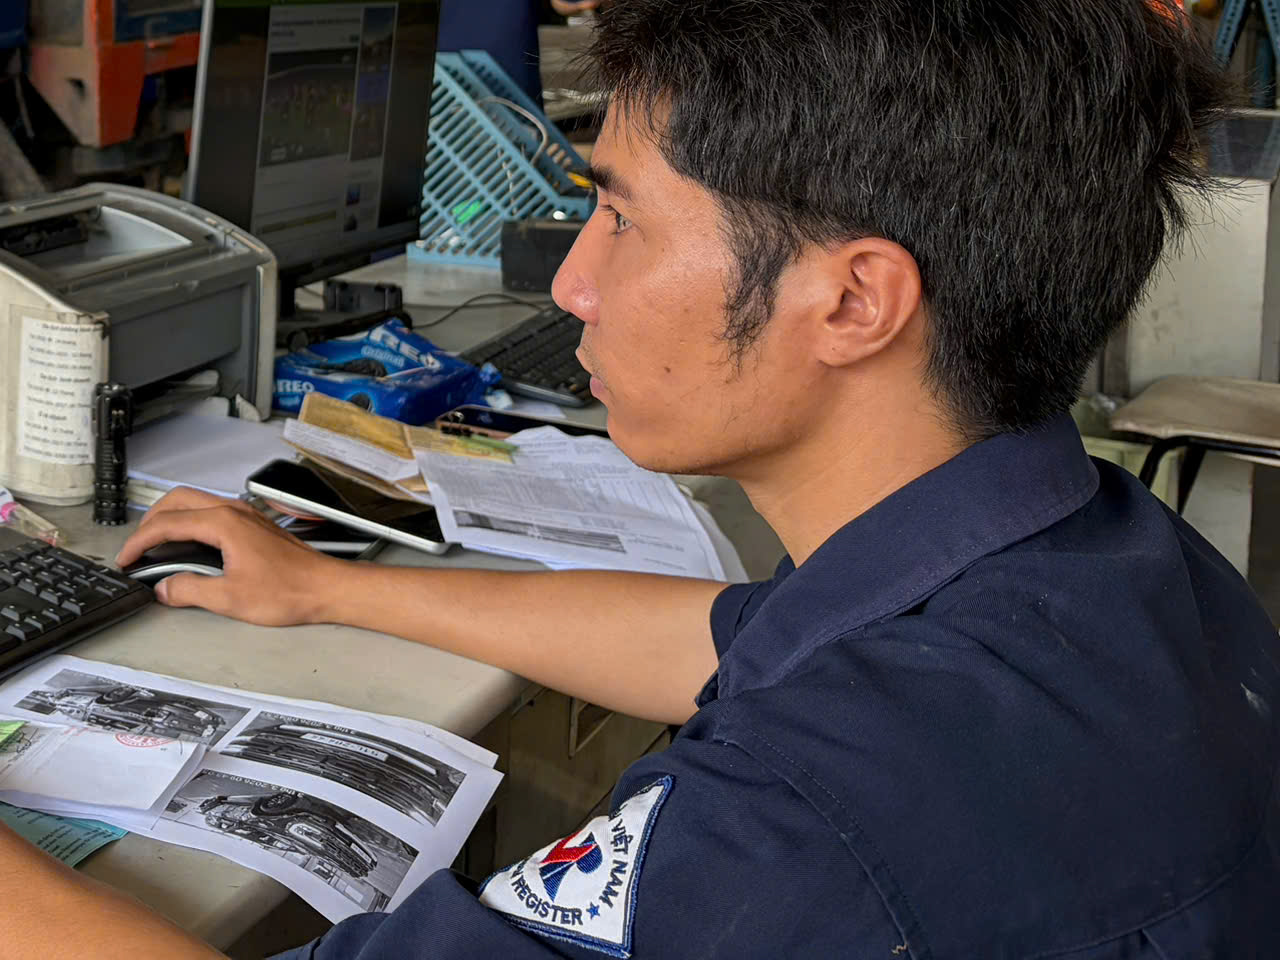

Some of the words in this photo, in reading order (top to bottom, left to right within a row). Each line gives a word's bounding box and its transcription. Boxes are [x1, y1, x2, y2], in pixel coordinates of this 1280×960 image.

[369, 325, 442, 370] REO
[274, 379, 315, 393] REO
[610, 817, 634, 855] VIỆT
[510, 875, 584, 926] REGISTER
[599, 860, 629, 908] NAM
